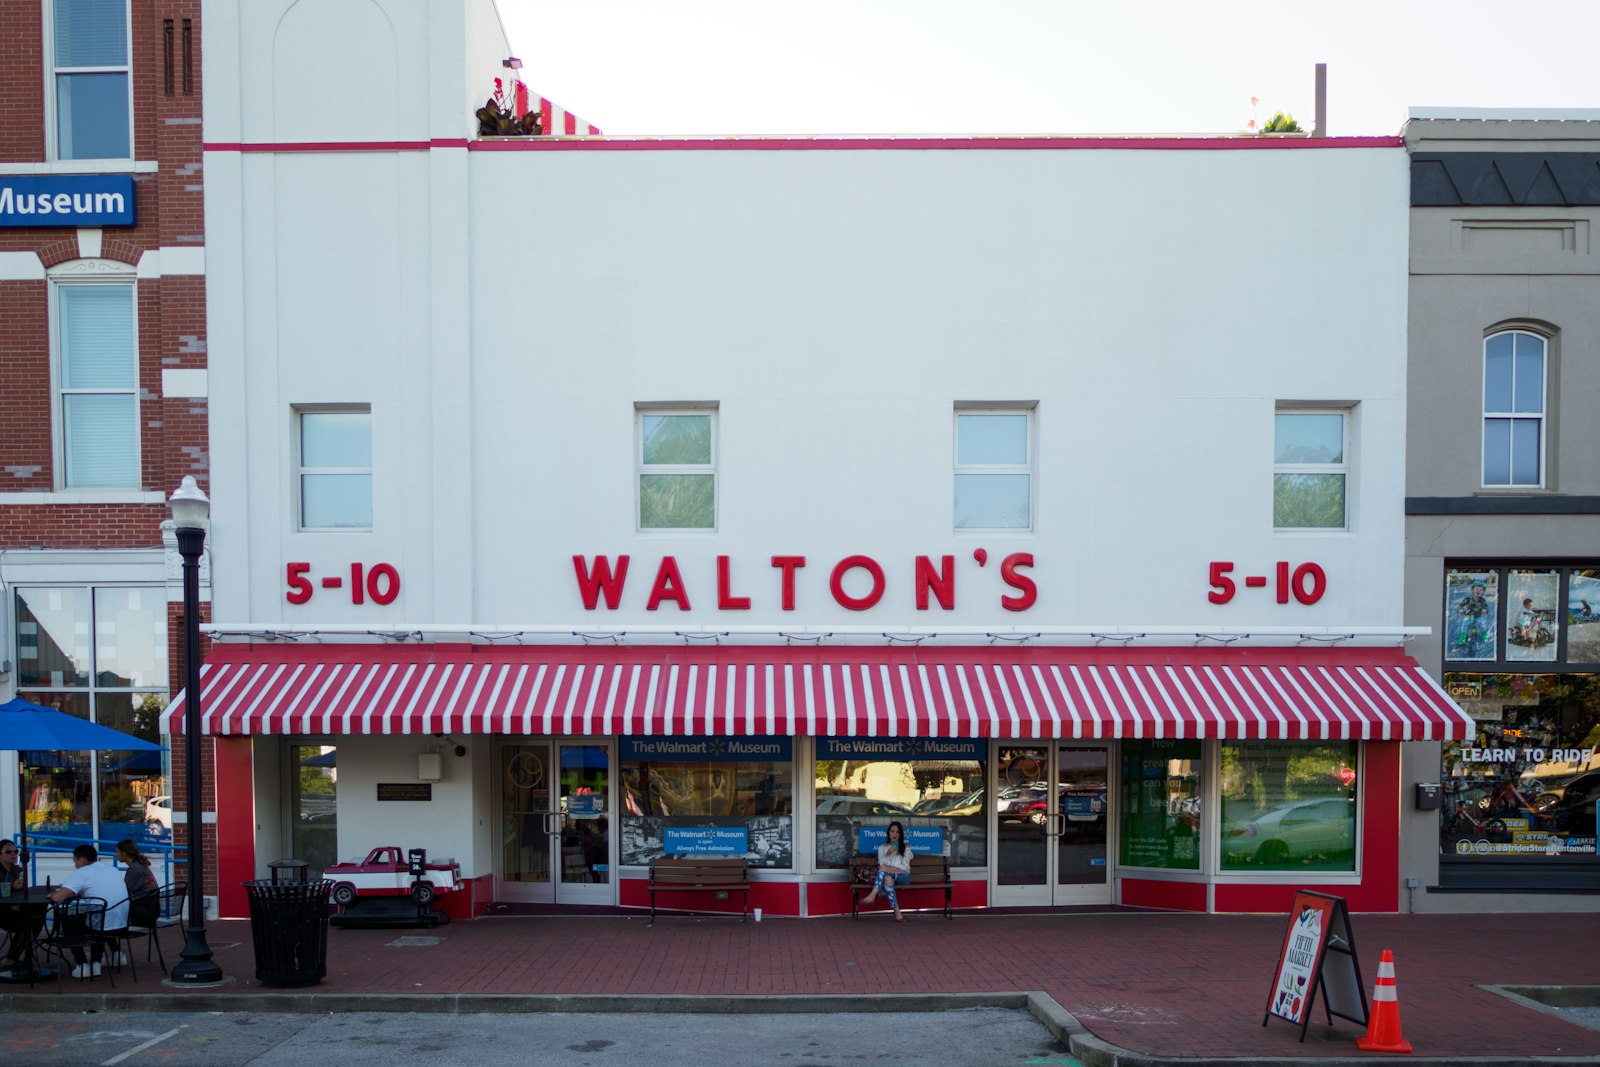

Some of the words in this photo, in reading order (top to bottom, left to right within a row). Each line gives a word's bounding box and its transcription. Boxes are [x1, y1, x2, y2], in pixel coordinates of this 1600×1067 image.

[0, 187, 125, 215] Museum
[287, 562, 400, 604] 5-10
[572, 548, 1037, 610] WALTON'S
[1208, 562, 1326, 604] 5-10
[1451, 687, 1478, 697] OPEN
[631, 741, 654, 753] The
[656, 741, 707, 753] Walmart
[728, 742, 781, 753] Museum
[827, 741, 851, 752] The
[853, 741, 903, 753] Walmart
[925, 741, 975, 753] Museum
[1462, 748, 1516, 762] LEARN
[1524, 748, 1544, 762] TO
[1163, 780, 1181, 790] you
[864, 830, 876, 838] The
[1287, 948, 1313, 969] MARKET
